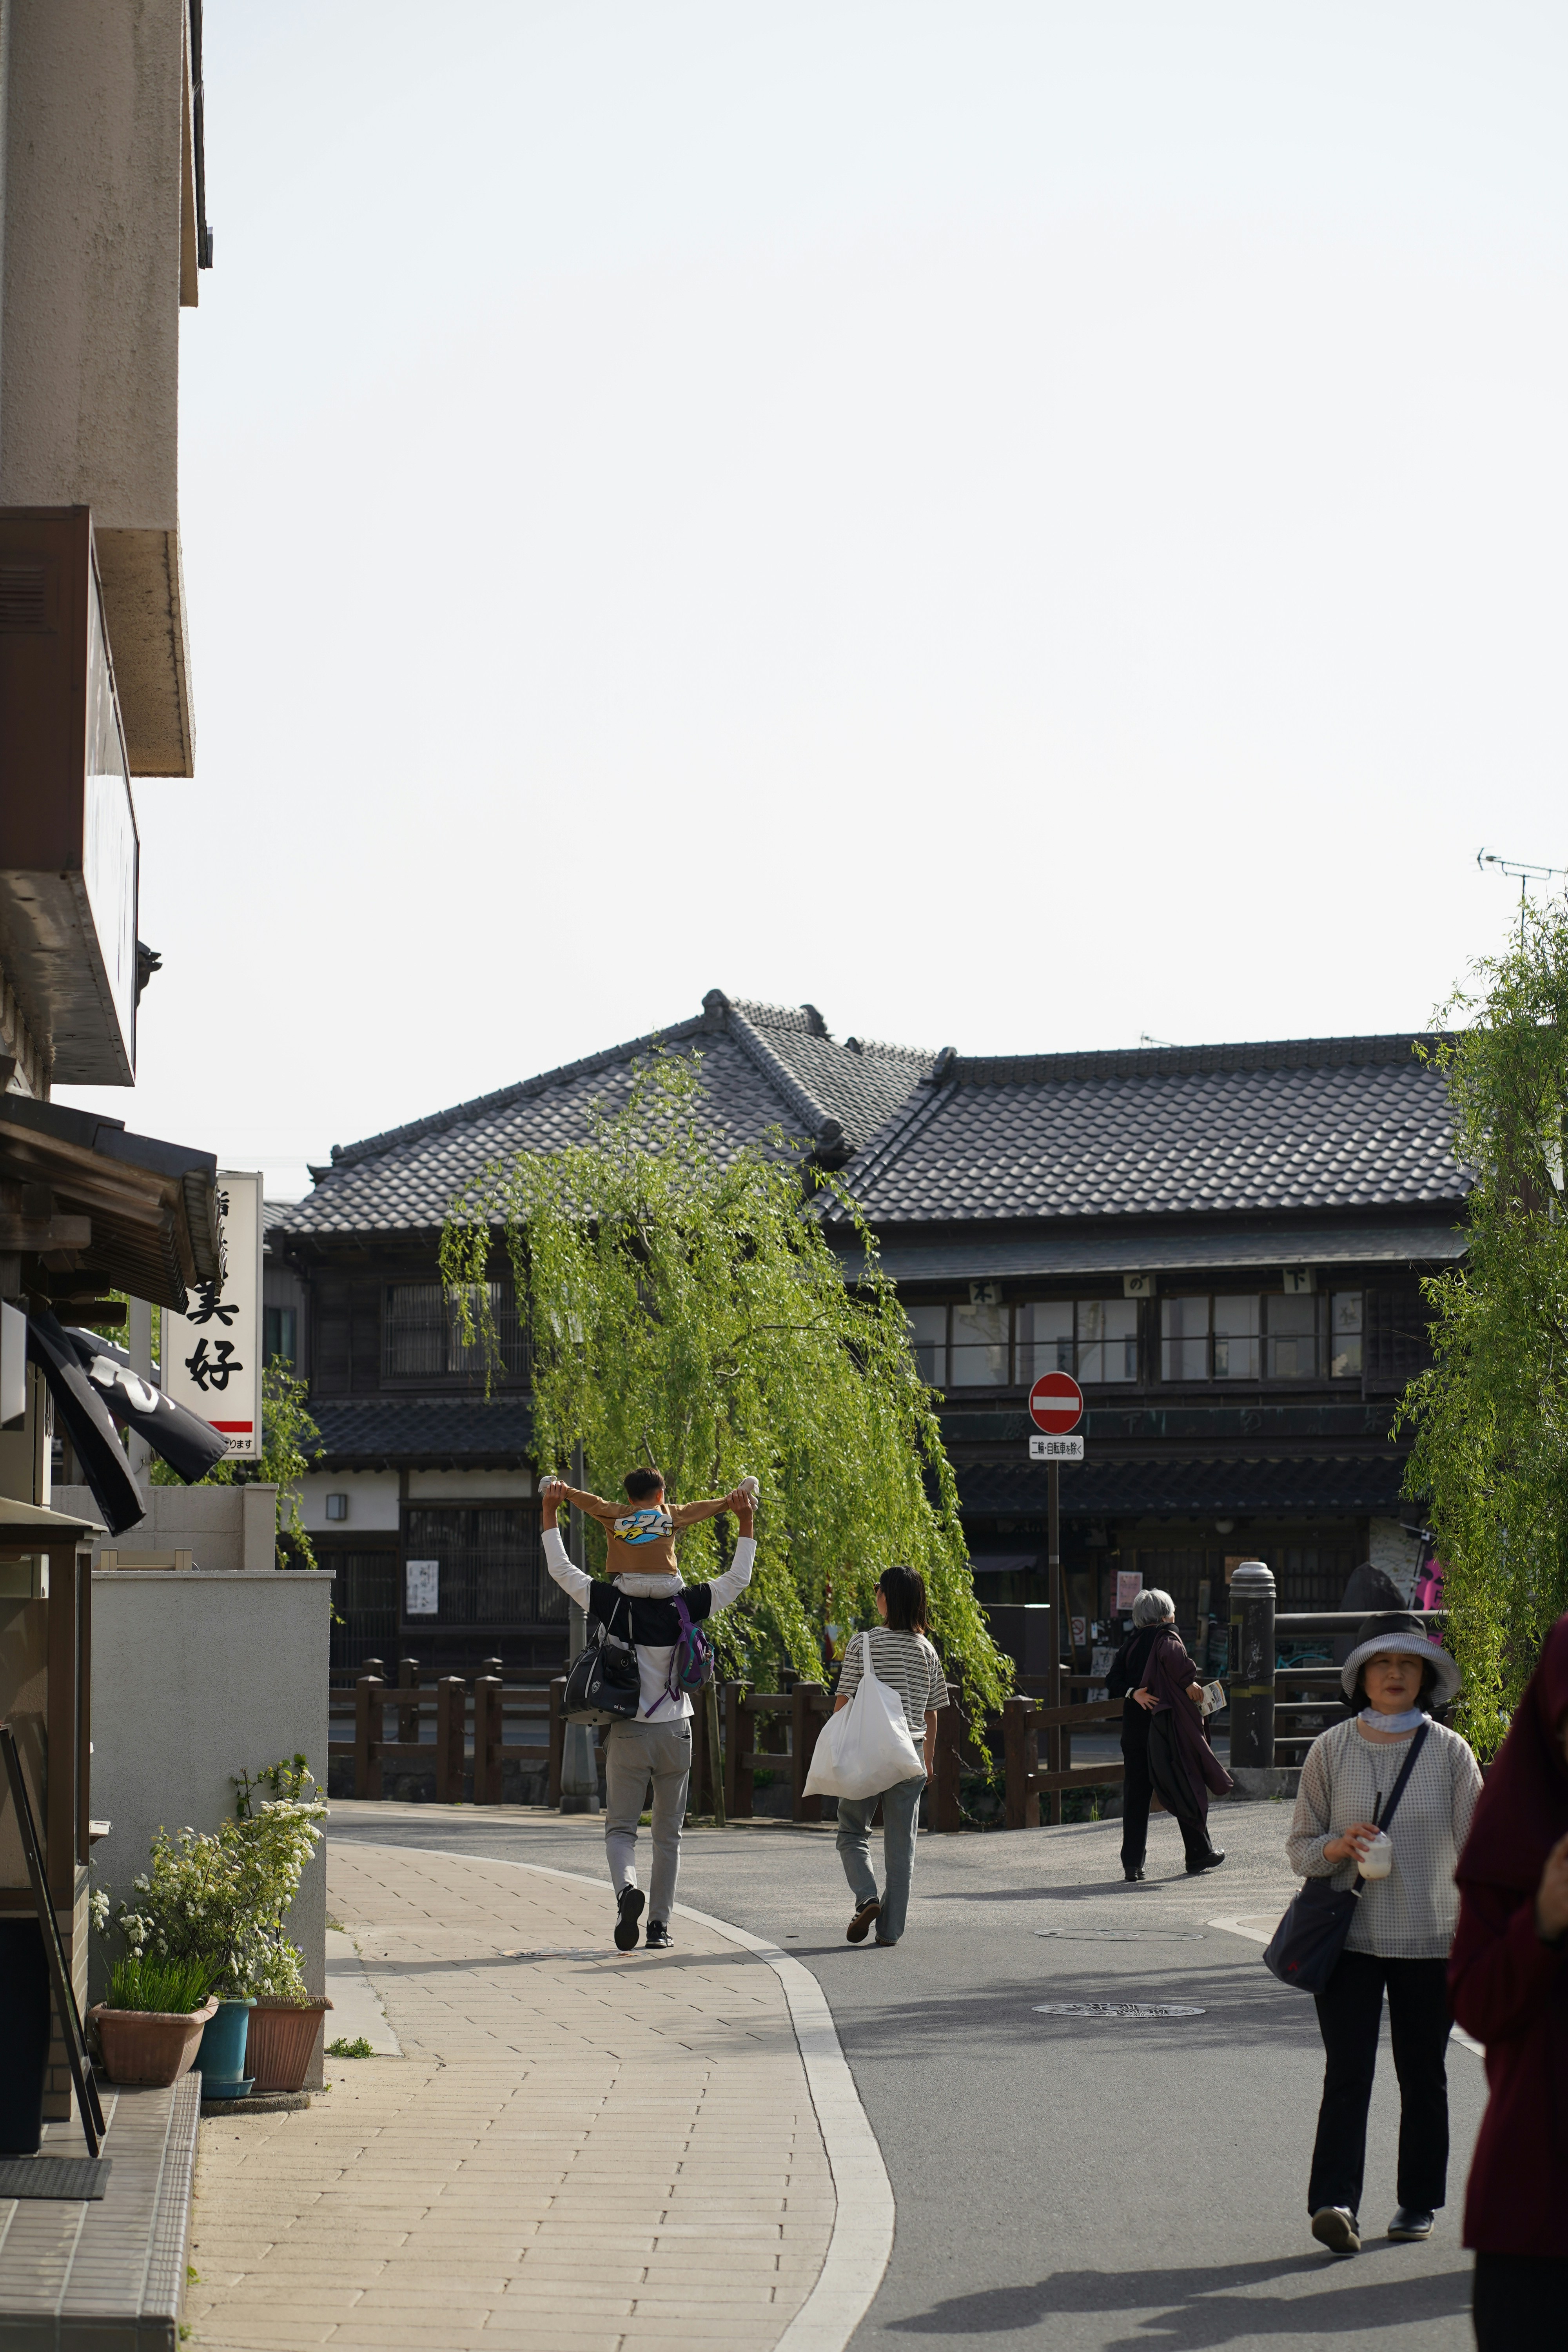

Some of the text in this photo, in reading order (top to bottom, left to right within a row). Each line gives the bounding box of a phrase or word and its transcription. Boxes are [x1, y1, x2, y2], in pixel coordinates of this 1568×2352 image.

[1130, 1277, 1143, 1290] の
[1286, 1268, 1306, 1291] 下
[1032, 1442, 1082, 1455] 二輪・自転車を除く
